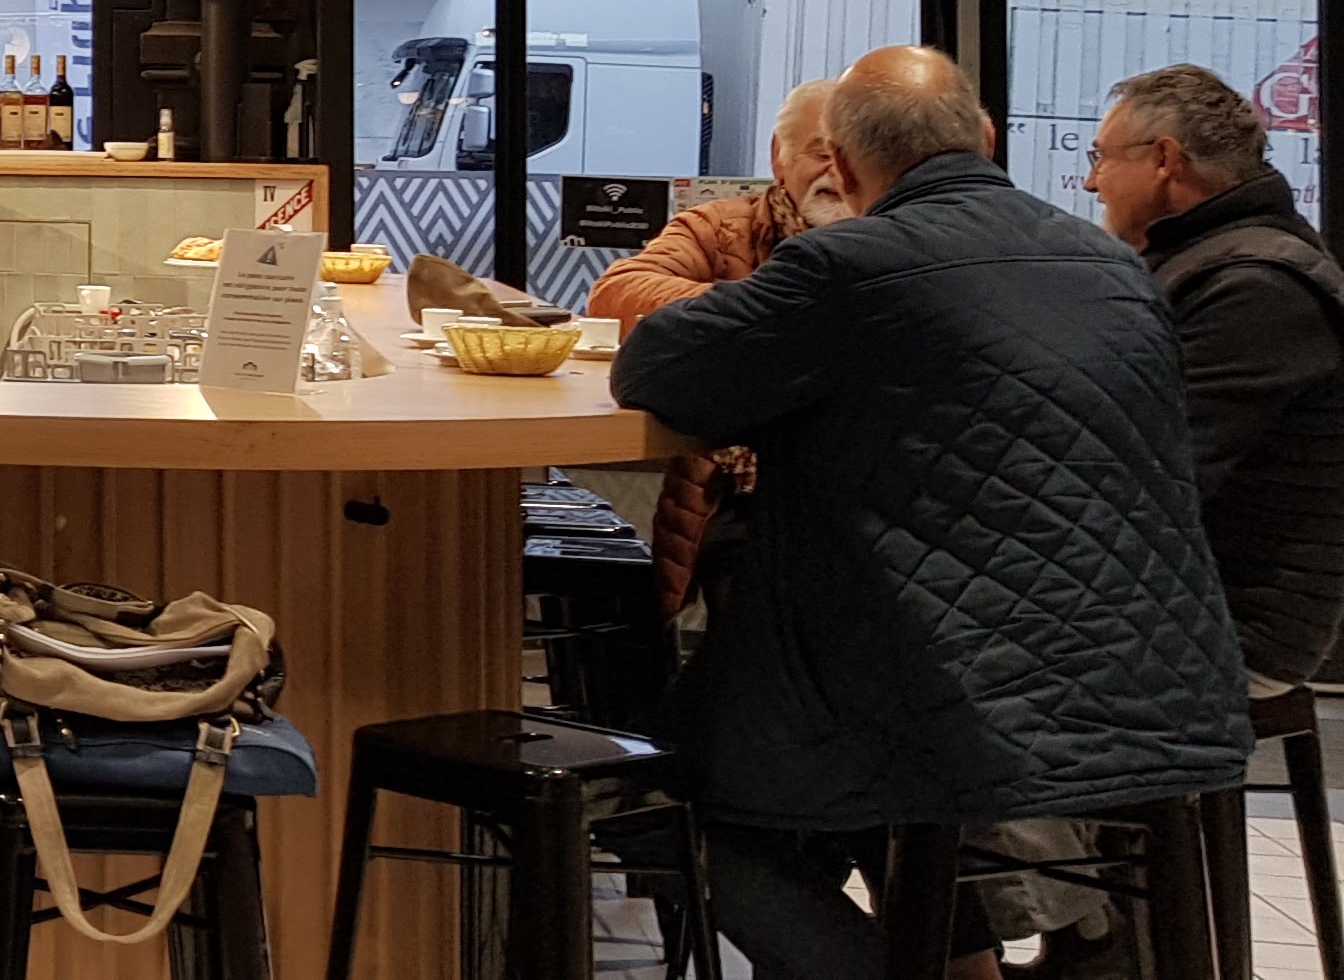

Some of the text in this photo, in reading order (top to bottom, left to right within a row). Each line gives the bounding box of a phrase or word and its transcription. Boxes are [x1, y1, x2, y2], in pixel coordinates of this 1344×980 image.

[1049, 124, 1079, 151] le
[263, 185, 277, 202] IV
[265, 186, 312, 229] CENCE
